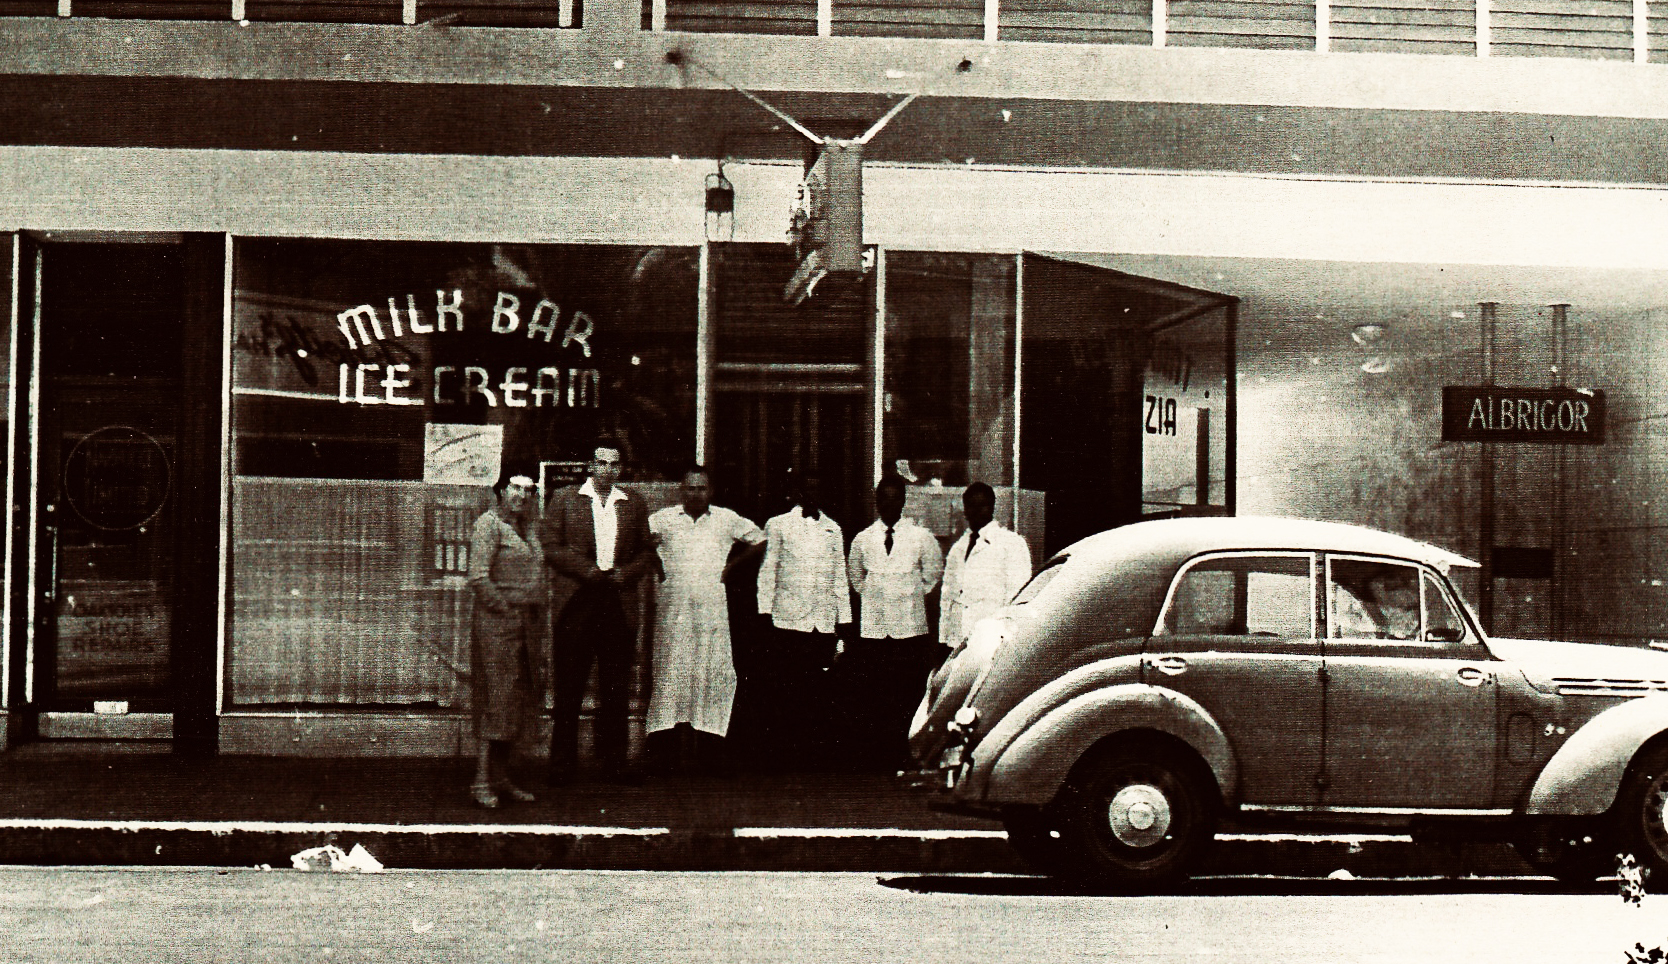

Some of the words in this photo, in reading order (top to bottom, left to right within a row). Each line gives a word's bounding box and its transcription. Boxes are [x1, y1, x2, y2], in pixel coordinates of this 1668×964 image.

[337, 289, 464, 350] MILK
[491, 291, 595, 357] BAR
[338, 363, 412, 405] ICE
[433, 366, 600, 408] CREAM
[1145, 395, 1177, 436] ZIA
[1467, 396, 1590, 433] ALBRIGOR
